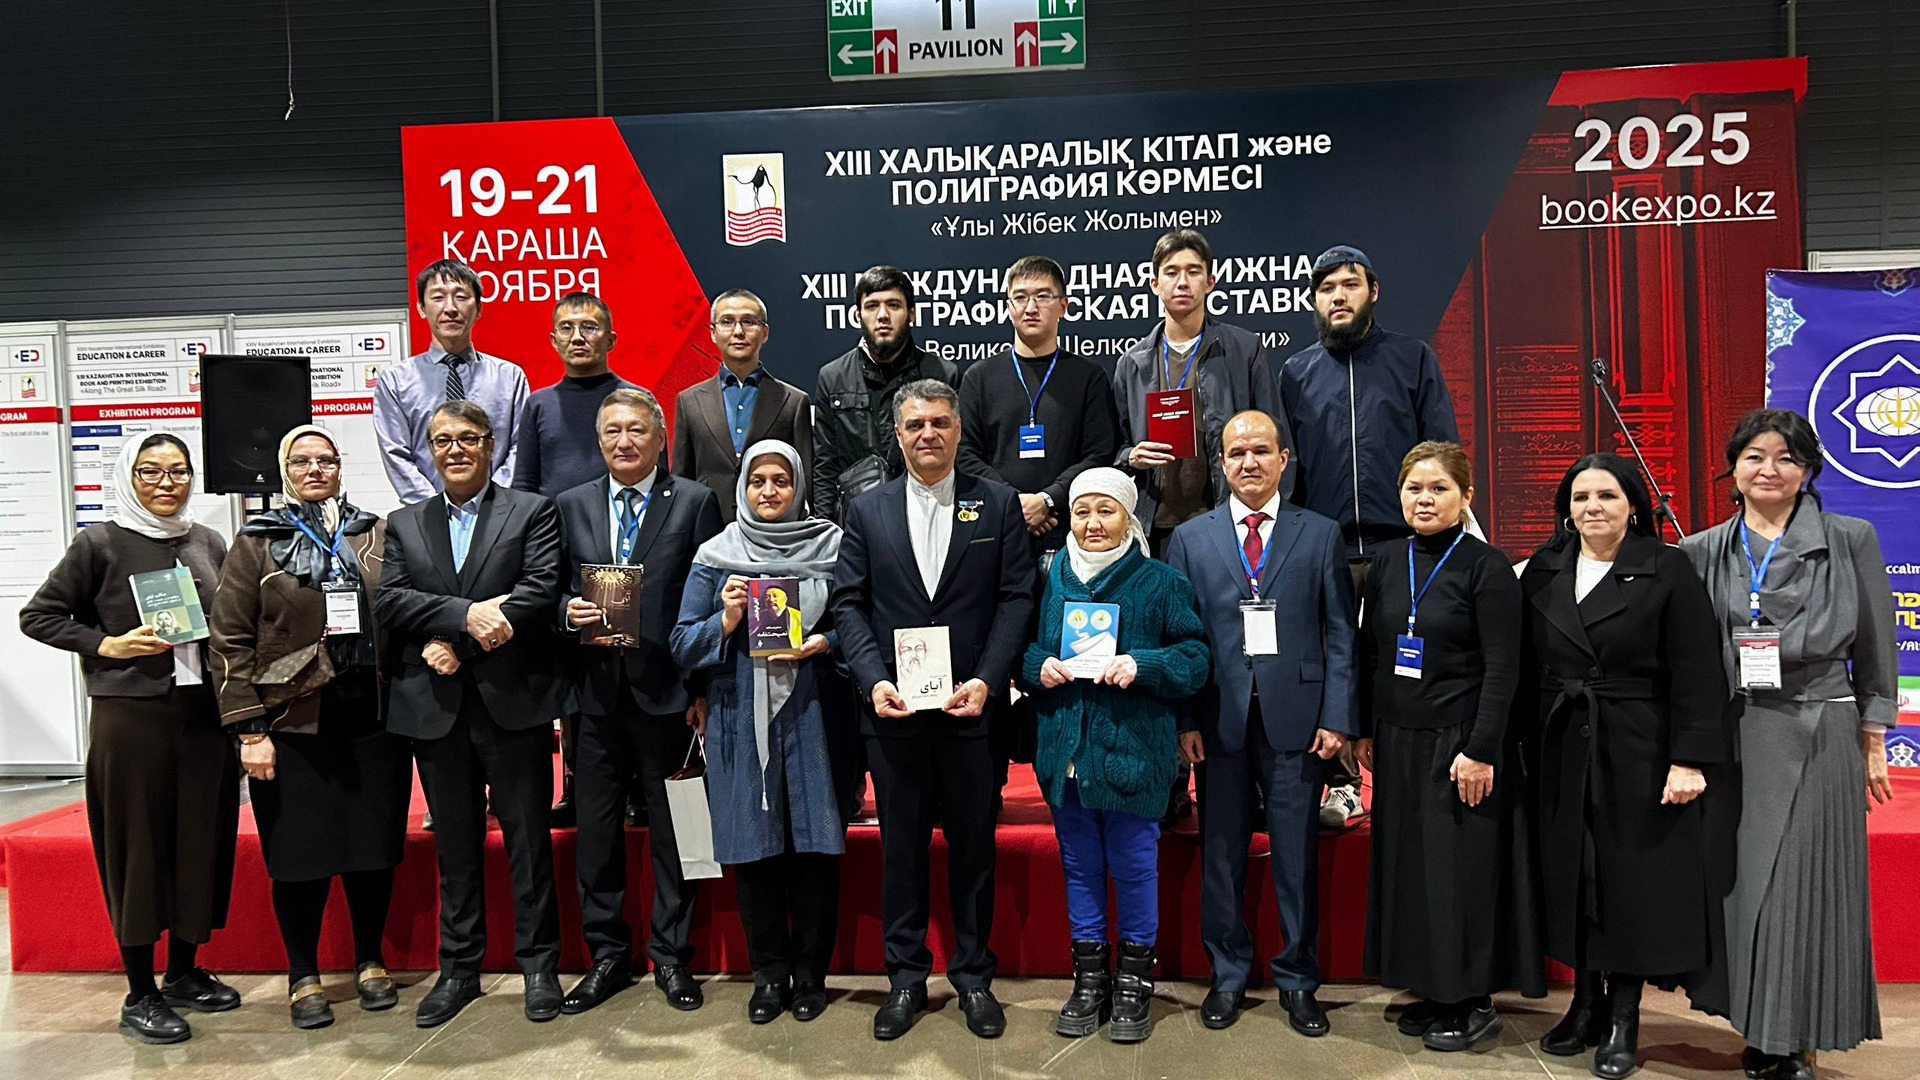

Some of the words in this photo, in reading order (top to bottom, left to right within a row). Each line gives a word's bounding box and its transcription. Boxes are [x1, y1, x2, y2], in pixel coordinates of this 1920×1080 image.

[831, 0, 868, 17] EXIT
[909, 38, 1003, 60] PAVILION
[825, 150, 871, 176] XIII
[879, 137, 1135, 176] ХАЛЫҚАРАЛЫҚ
[1142, 132, 1239, 163] КІТАП
[1247, 133, 1332, 158] және
[1574, 111, 1750, 172] 2025
[440, 164, 598, 217] 19-21
[892, 172, 1107, 205] ПОЛИГРАФИЯ
[1116, 163, 1263, 196] КӨРМЕСІ
[1540, 185, 1777, 227] bookexpo.kz
[930, 215, 995, 237] «Ұлы
[1002, 211, 1077, 236] Жібек
[1084, 208, 1223, 232] Жолымен»
[443, 226, 608, 265] ҚАРАША
[1211, 254, 1312, 284] ИЖНА
[479, 268, 600, 302] ОЯБРЯ
[1158, 286, 1315, 317] СТАВК
[77, 352, 124, 360] EDUCATION
[125, 351, 132, 359] &
[132, 350, 166, 359] CAREER
[246, 346, 297, 357] EDUCATION
[298, 346, 304, 354] &
[305, 345, 341, 354] CAREER
[99, 407, 150, 418] EXHIBITION
[151, 406, 196, 417] PROGRAM
[324, 402, 372, 413] PROGRAM
